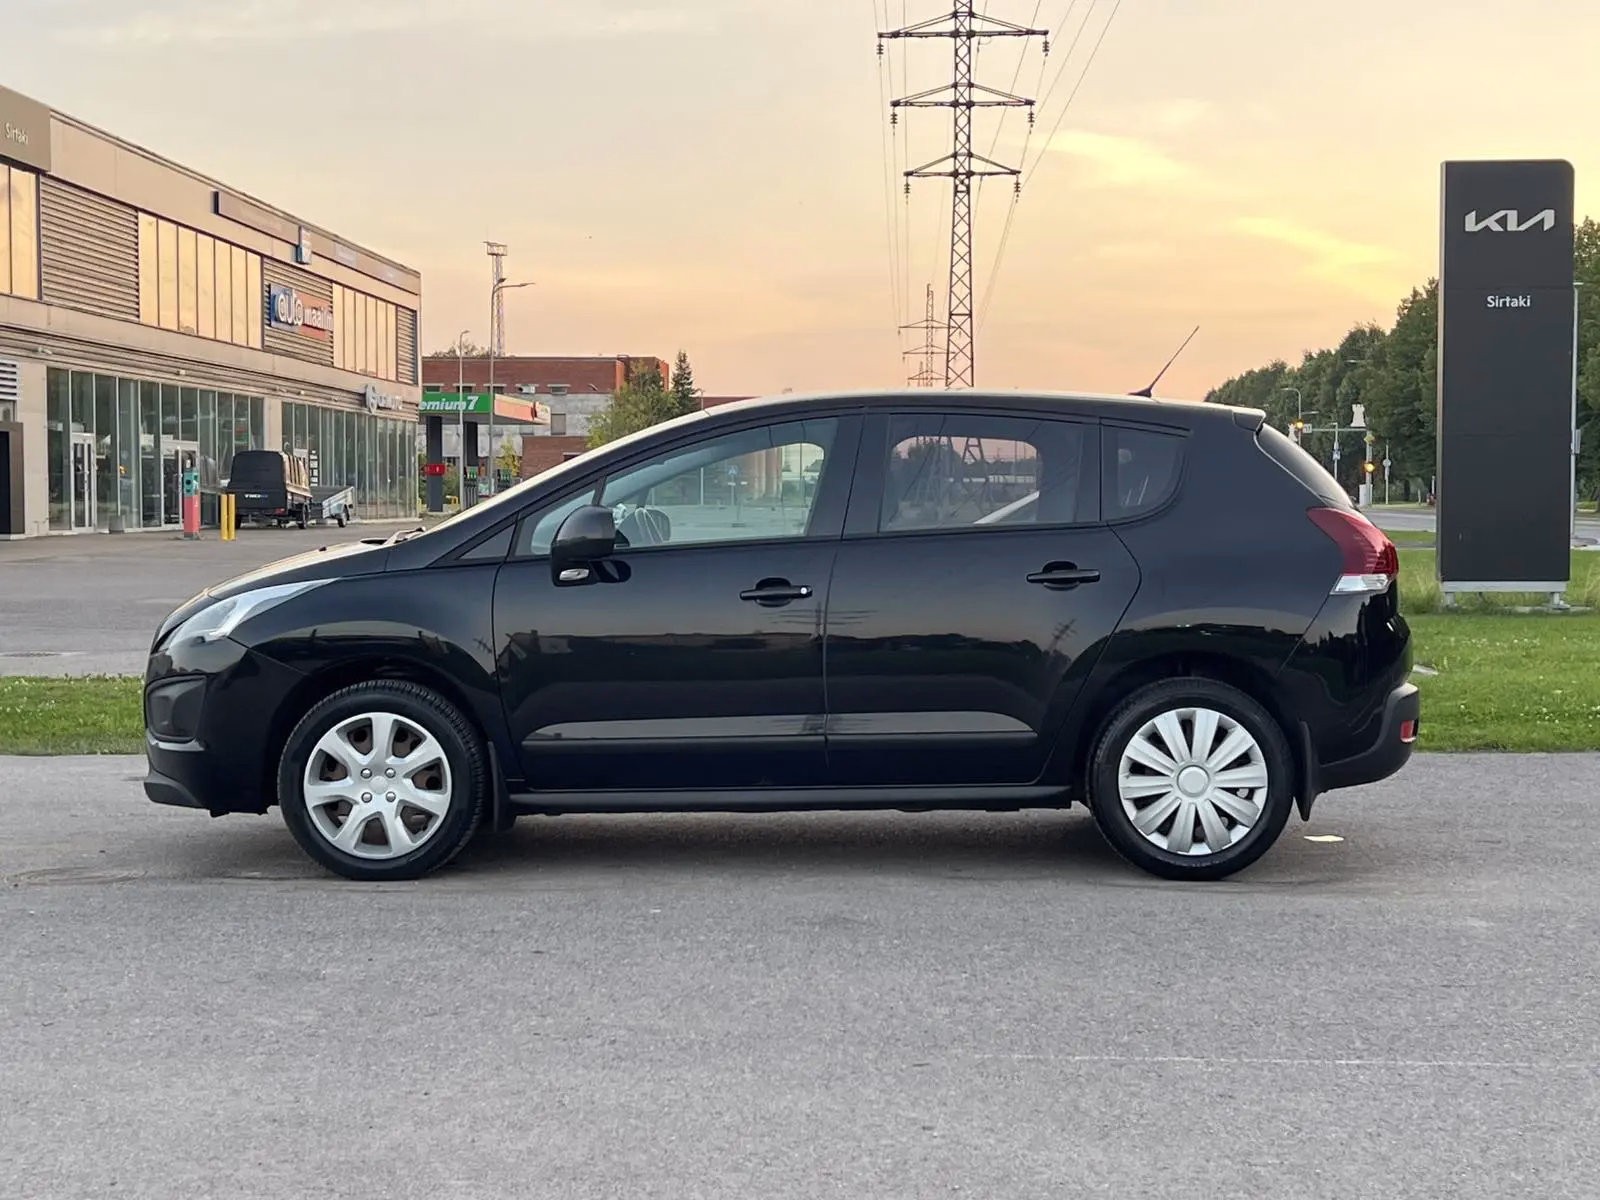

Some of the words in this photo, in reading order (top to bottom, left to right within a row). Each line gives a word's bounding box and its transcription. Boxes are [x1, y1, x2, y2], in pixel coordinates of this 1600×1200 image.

[1465, 208, 1555, 232] KIA
[1486, 295, 1531, 308] Sirtaki
[418, 396, 479, 411] emium7
